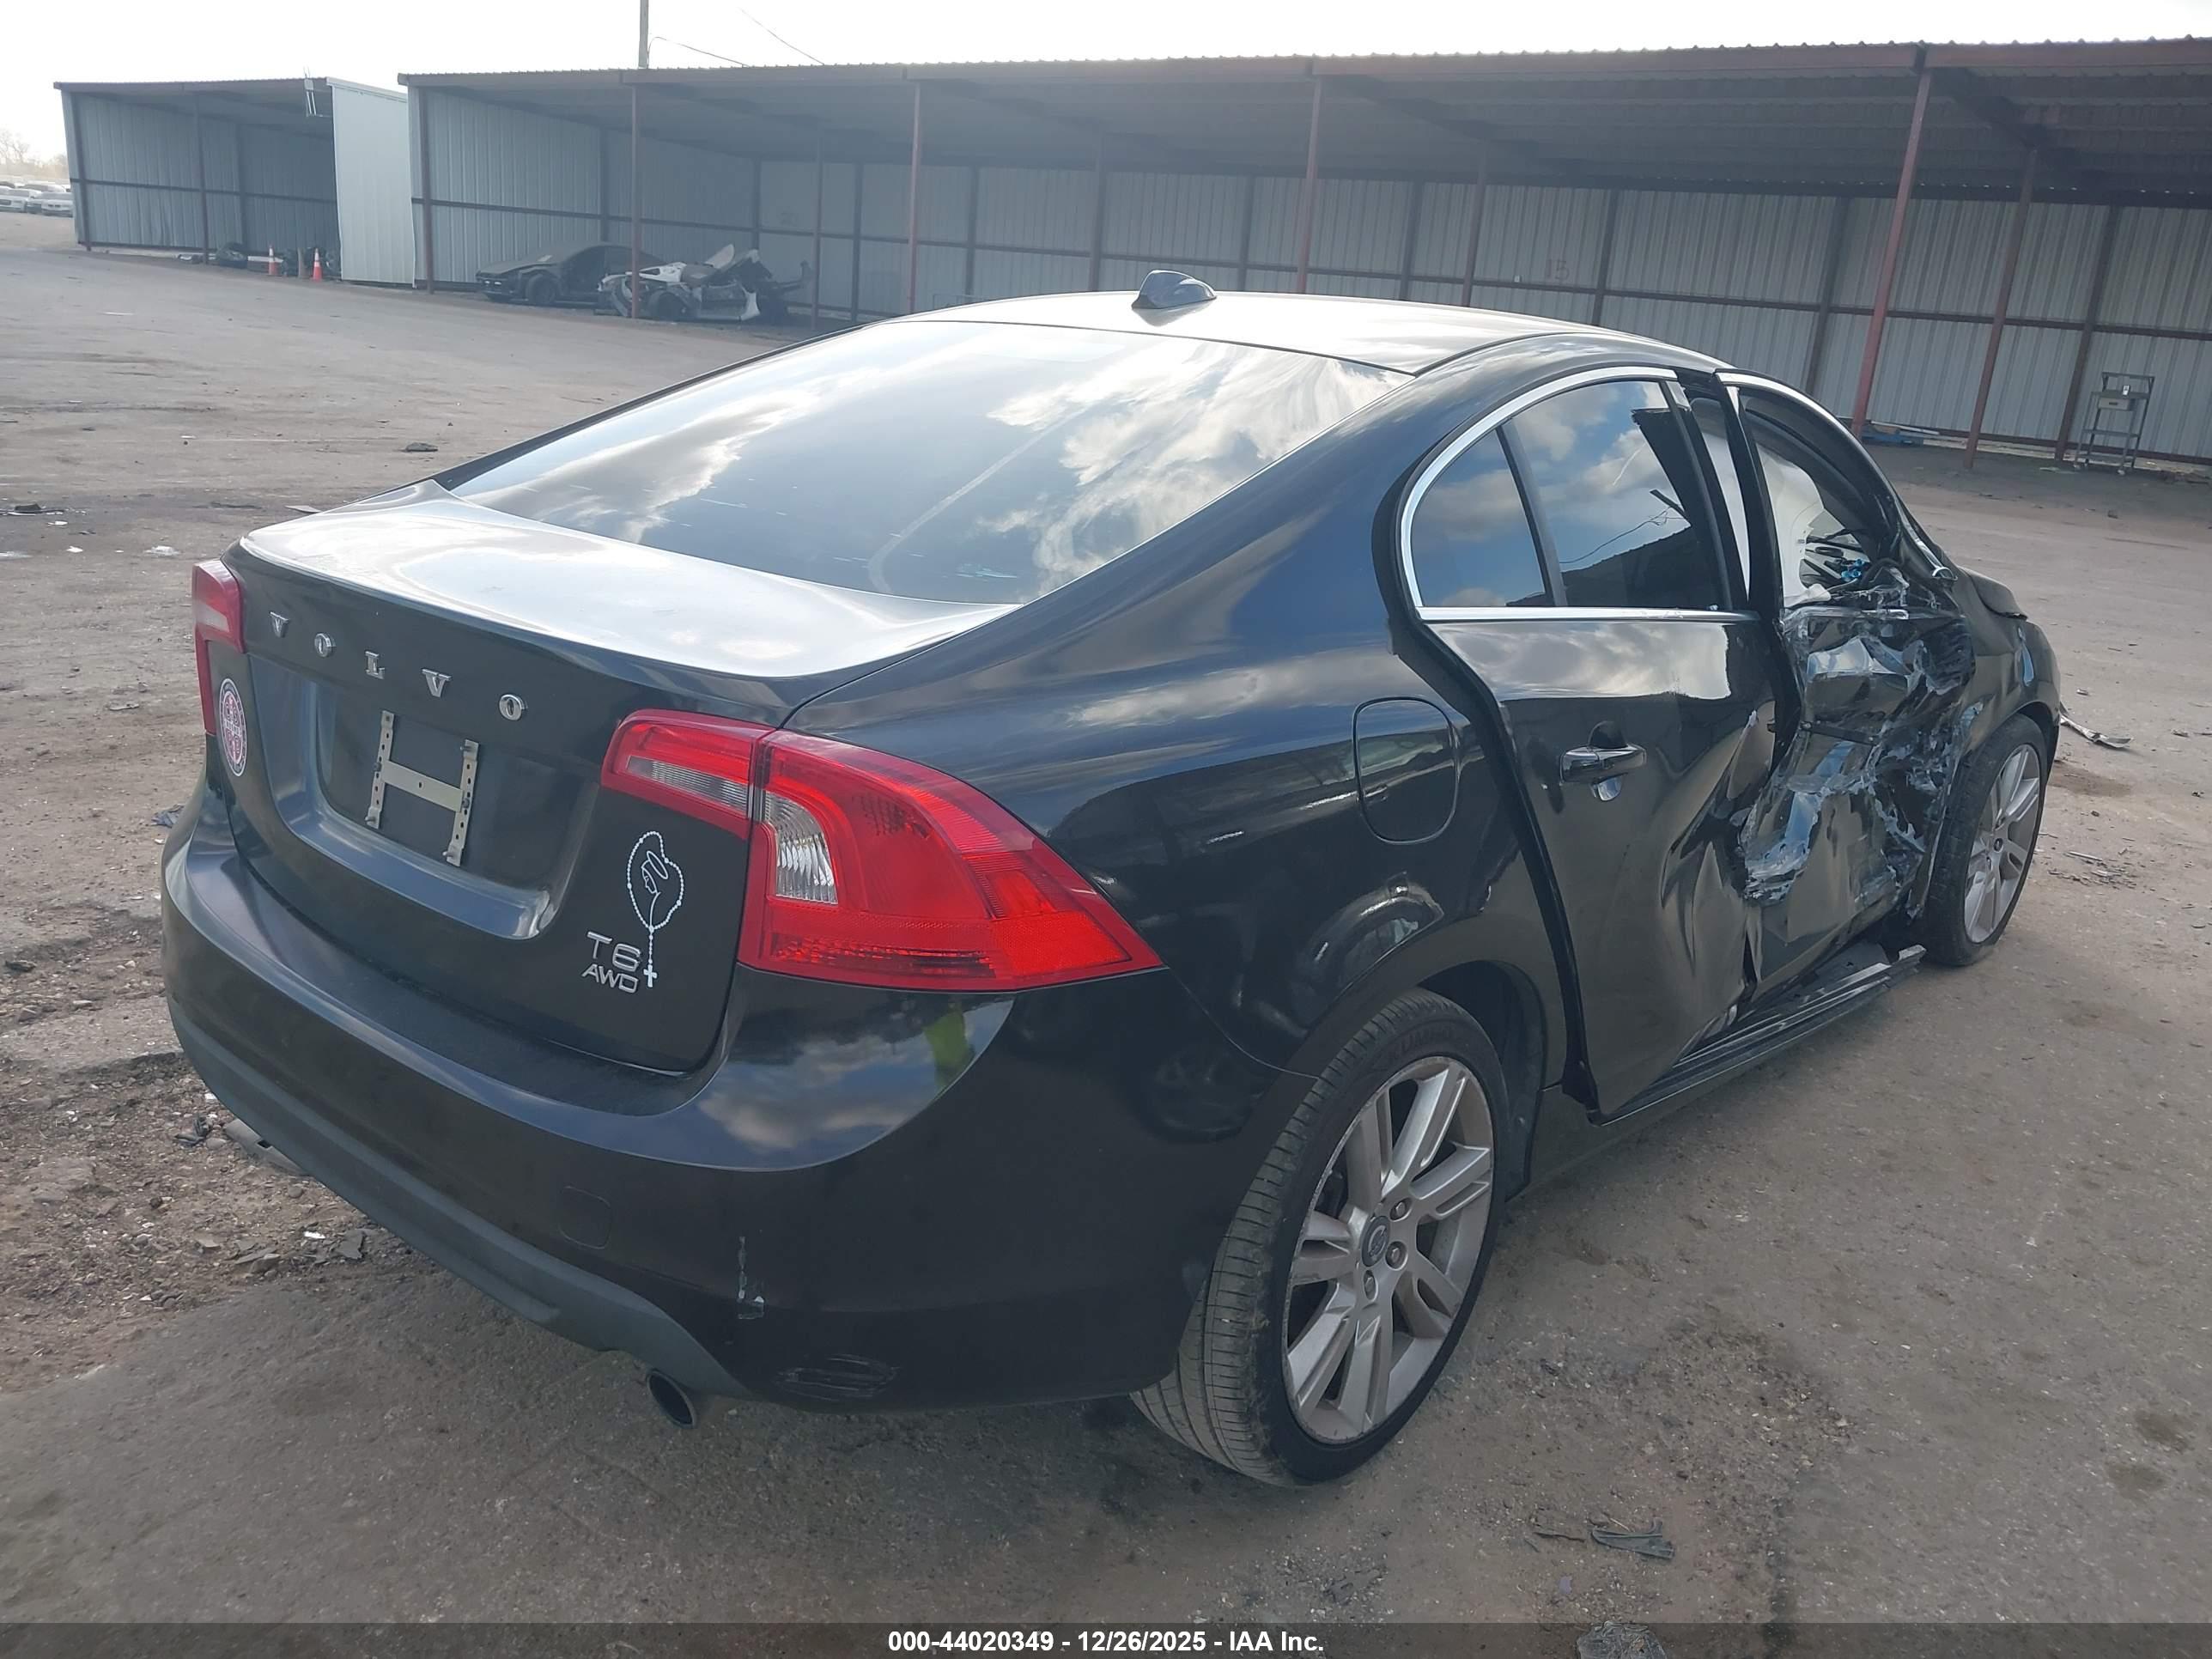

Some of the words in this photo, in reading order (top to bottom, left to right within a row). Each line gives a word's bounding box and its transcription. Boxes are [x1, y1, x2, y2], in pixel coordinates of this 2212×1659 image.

[269, 611, 527, 721] VOLVO
[587, 931, 641, 972] T6
[581, 963, 639, 994] AWD
